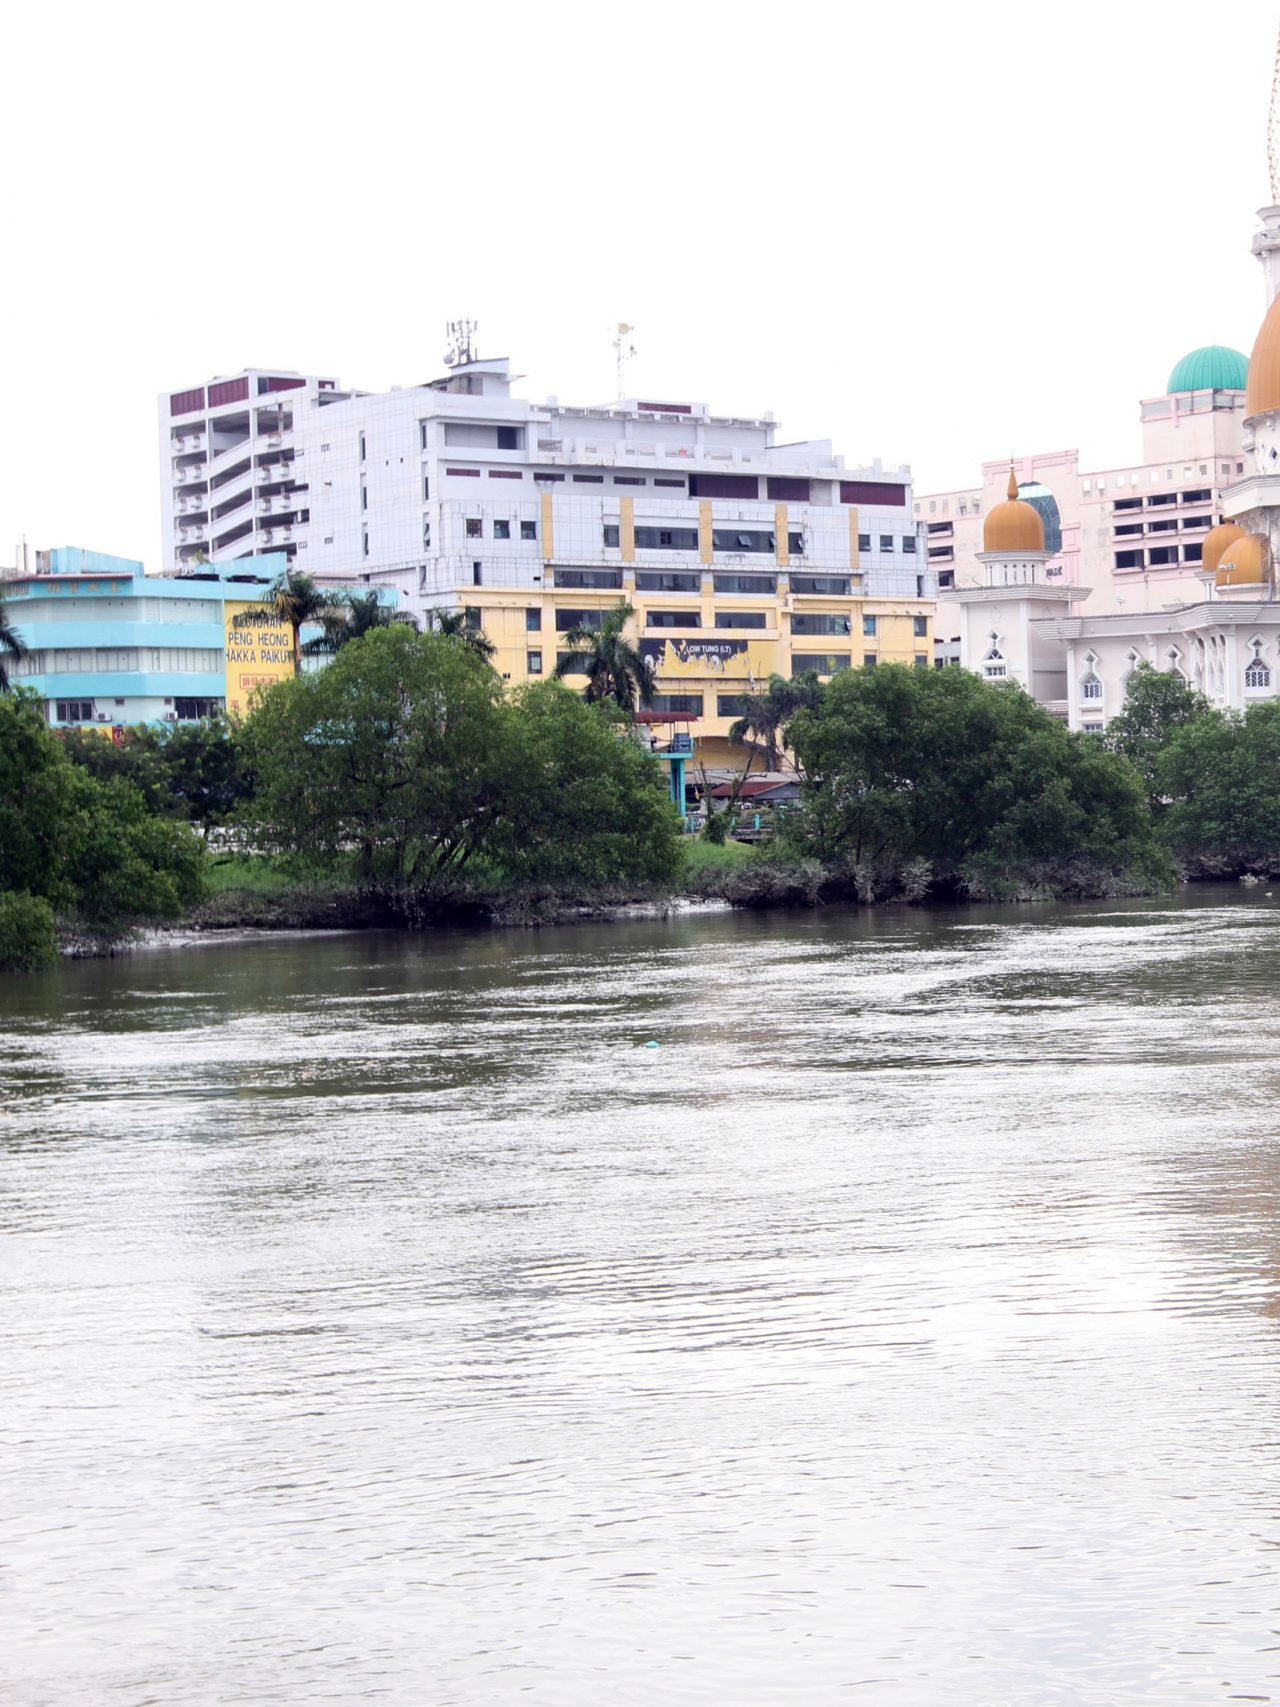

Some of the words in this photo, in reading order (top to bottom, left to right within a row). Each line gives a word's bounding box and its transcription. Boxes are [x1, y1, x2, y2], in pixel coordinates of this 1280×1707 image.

[228, 632, 253, 646] PENG
[257, 632, 289, 647] HEONG
[701, 645, 719, 653] TUNG
